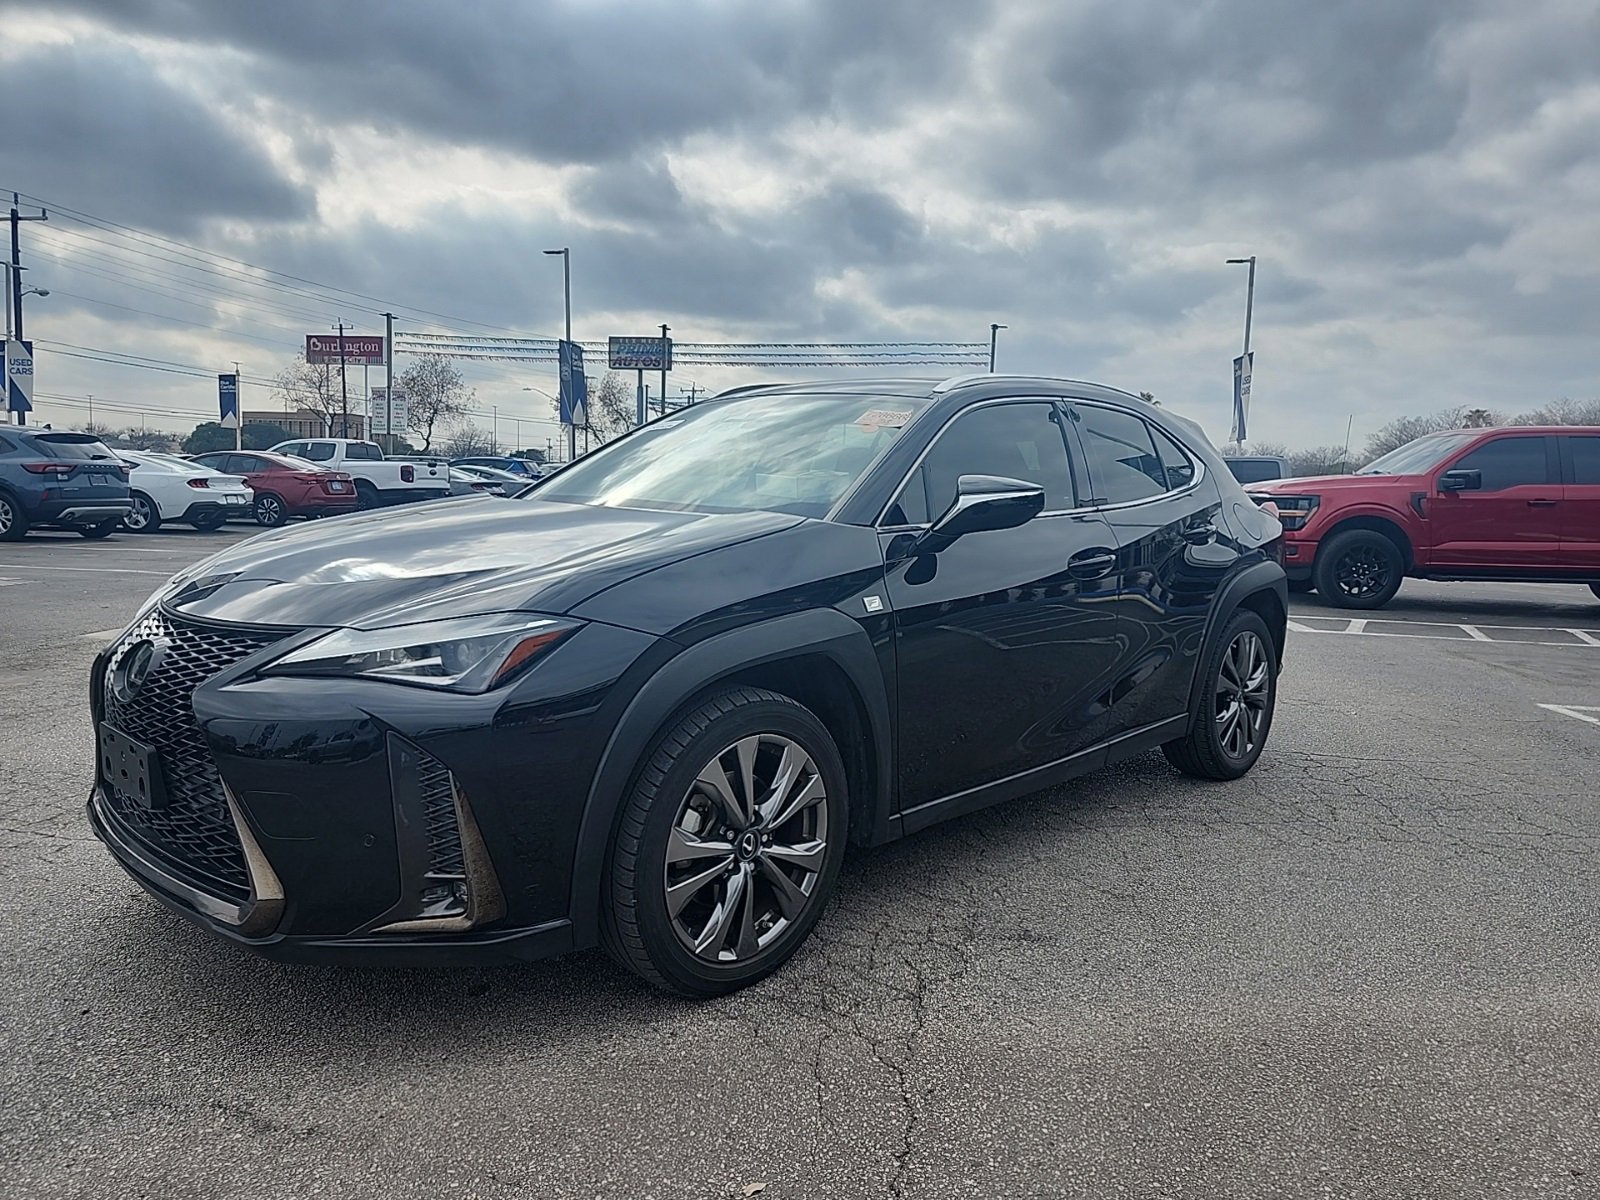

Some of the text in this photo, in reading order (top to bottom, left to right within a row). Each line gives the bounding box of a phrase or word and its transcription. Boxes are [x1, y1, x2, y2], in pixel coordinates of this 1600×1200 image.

[310, 337, 379, 355] Burlngton
[9, 358, 33, 367] USED
[612, 356, 662, 367] AUTOS
[9, 367, 33, 375] CARS
